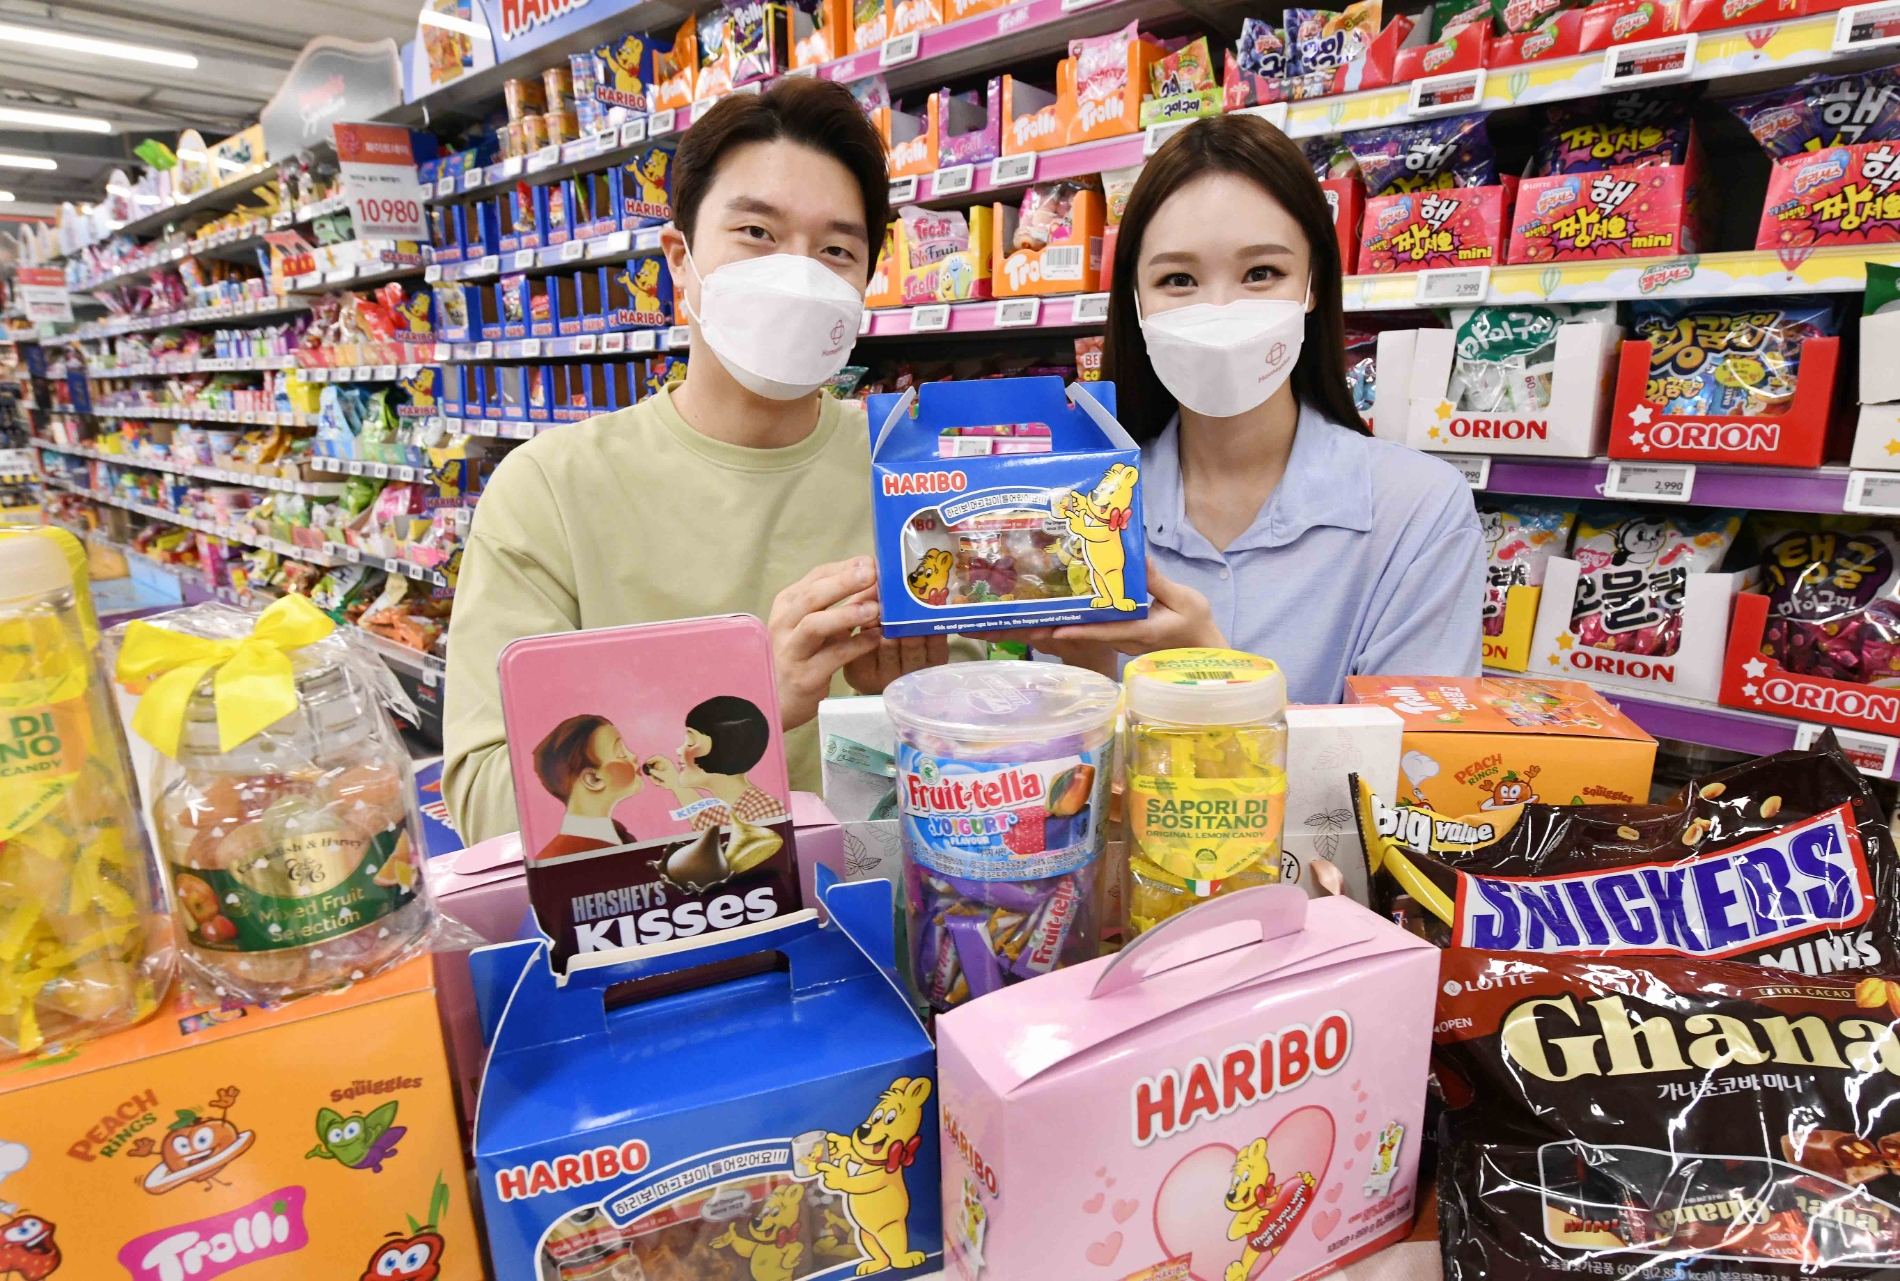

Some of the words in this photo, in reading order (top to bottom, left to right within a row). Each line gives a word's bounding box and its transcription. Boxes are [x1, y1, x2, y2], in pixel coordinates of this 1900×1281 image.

[597, 87, 646, 110] HARIBO
[1079, 95, 1125, 132] Trolli
[1823, 82, 1889, 144] 핵
[1013, 109, 1056, 146] Trolli
[893, 142, 928, 171] Trolli
[1405, 138, 1457, 180] 핵
[626, 202, 671, 218] HARIBO
[1590, 174, 1640, 217] 핵
[1420, 193, 1460, 232] 핵
[1552, 206, 1627, 248] 짱셔요
[914, 218, 950, 242] Trolli
[1391, 222, 1454, 260] 짱셔요
[1631, 233, 1673, 249] mini
[383, 252, 421, 264] HARIBO
[1458, 246, 1493, 260] mini
[904, 271, 940, 300] Trolli
[1004, 253, 1048, 291] Trol
[618, 311, 664, 326] HARIBO
[397, 332, 435, 343] HARIBO
[398, 406, 437, 417] HARIBO
[1449, 418, 1548, 440] ORION
[1651, 423, 1780, 451] ORION
[884, 472, 967, 495] HARIBO
[1654, 481, 1684, 491] 2,990
[1569, 652, 1674, 683] ORION
[1763, 678, 1899, 723] ORION
[9, 713, 55, 739] DI
[1, 759, 62, 777] CANDY
[1453, 753, 1503, 786] PEACH
[907, 770, 1044, 812] Fruit-tella
[1146, 814, 1268, 829] POSITANO
[1147, 799, 1238, 814] SAPORI
[1245, 799, 1268, 814] DI
[306, 840, 316, 849] &
[950, 836, 991, 847] FLAVOUR
[1146, 830, 1192, 839] ORIGINAL
[1232, 831, 1266, 839] CANDY
[1435, 820, 1495, 845] value
[571, 880, 668, 923] HERSHEY'S
[1472, 823, 1857, 951] SNICKERS
[258, 901, 318, 924] Mixed
[322, 888, 365, 912] Fruit
[271, 909, 361, 943] Selection
[1758, 930, 1883, 976] MINIS
[1465, 973, 1534, 992] LOTTE
[1758, 986, 1802, 1000] EXTRA
[1805, 988, 1851, 1000] CACAO
[1440, 1017, 1473, 1033] OPEN
[1502, 993, 1900, 1082] Ghana
[1136, 1015, 1349, 1142] HARIBO
[1657, 1075, 1761, 1102] 가나초코바
[1763, 1073, 1803, 1094] 미니
[66, 1088, 160, 1163] PEACH
[942, 1103, 998, 1198] HARIBO
[500, 1142, 648, 1200] HARIBO
[616, 1190, 654, 1215] 하리보
[656, 1166, 708, 1195] 머그컵이
[711, 1151, 788, 1176] 들어있어요!!!
[1251, 1219, 1277, 1248] Thank
[1277, 1205, 1291, 1225] you
[1290, 1184, 1306, 1208] with
[1263, 1233, 1274, 1247] all
[1274, 1221, 1288, 1237] my
[1286, 1197, 1306, 1222] heart
[142, 1200, 290, 1281] Trolli
